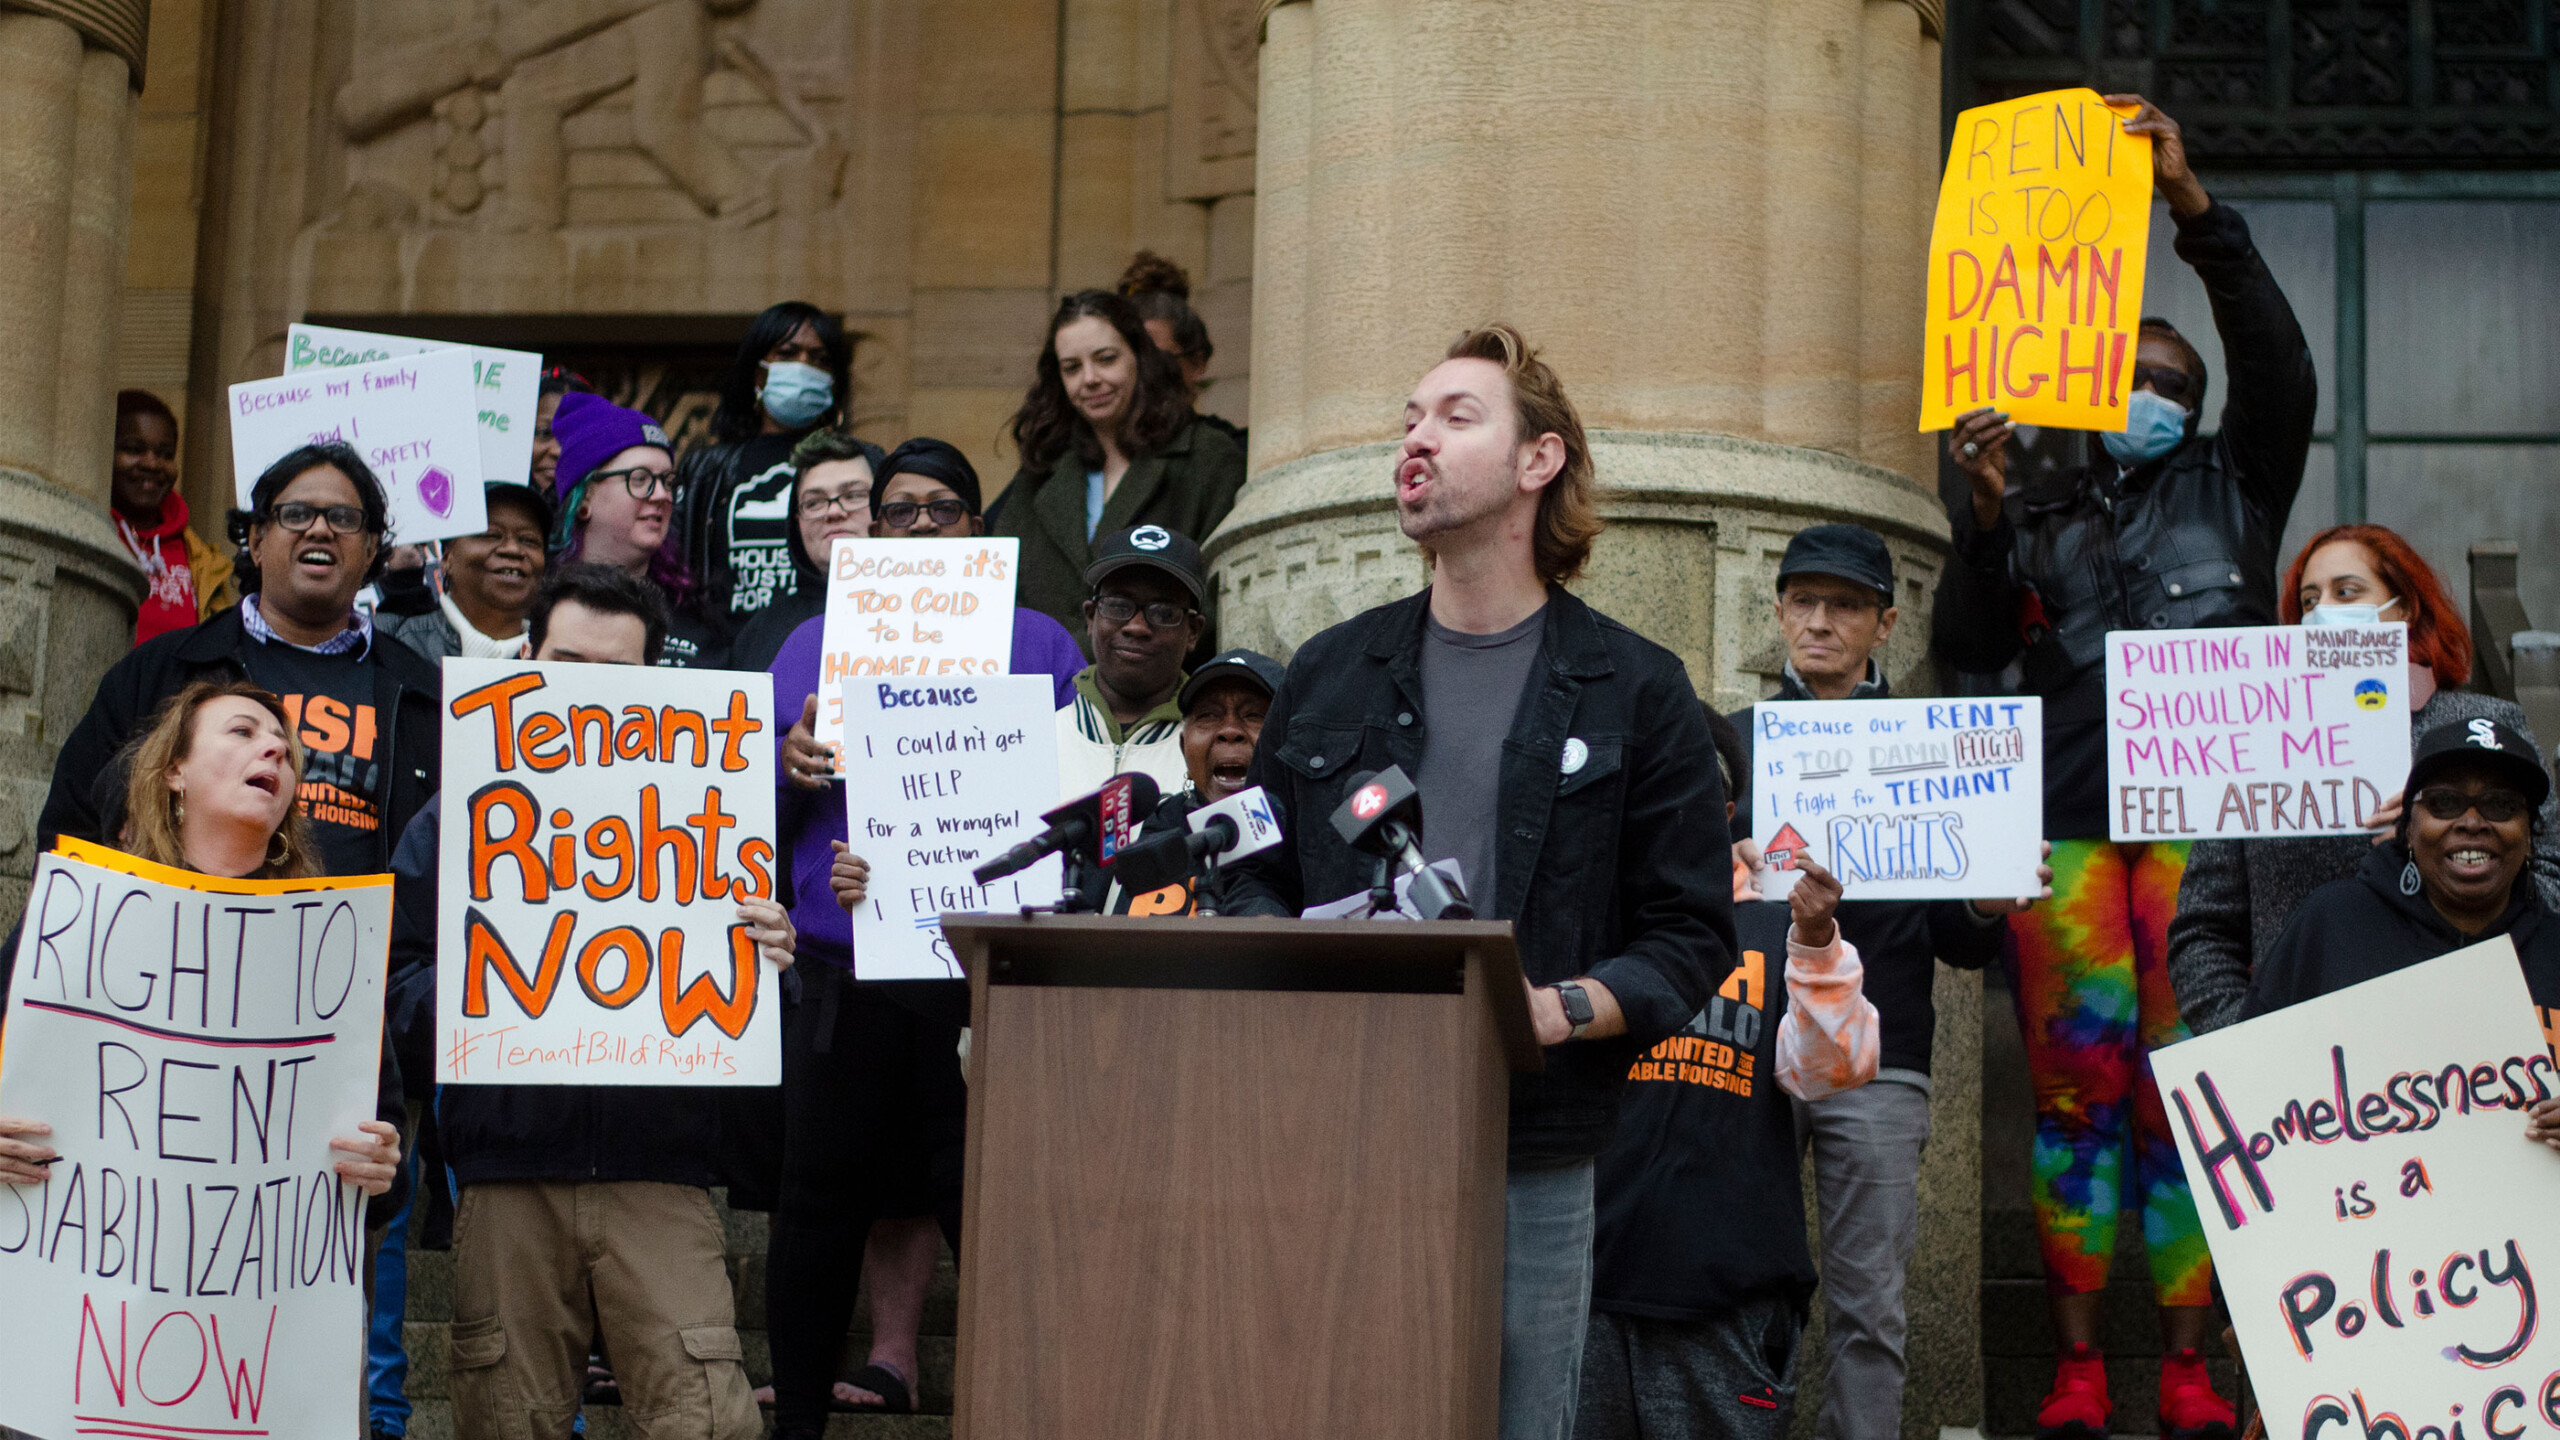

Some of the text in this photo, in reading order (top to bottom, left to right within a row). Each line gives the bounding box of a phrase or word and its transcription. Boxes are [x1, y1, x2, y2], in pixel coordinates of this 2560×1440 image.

[1967, 101, 2116, 180] RENT
[1970, 186, 2112, 246] IS TOO
[1948, 243, 2122, 328] DAMN
[1944, 325, 2127, 407] HIGH!
[238, 367, 418, 416] Because my family
[307, 416, 359, 446] and I
[370, 438, 431, 469] SAFETY
[836, 547, 1007, 580] Because it's
[730, 588, 772, 612] FOR
[847, 587, 979, 616] TOO COLD
[868, 618, 944, 643] to be
[2305, 629, 2402, 648] MAINTENANCE
[825, 652, 999, 684] HOMELESS
[2120, 633, 2290, 677] PUTTING IN
[2306, 650, 2398, 669] REQUESTS
[878, 683, 978, 710] Because
[2116, 673, 2325, 730] SHOULDN'T
[450, 671, 763, 773] Tenant
[865, 734, 873, 758] I
[996, 728, 1026, 752] get
[1762, 704, 2023, 740] Because our RENT
[1768, 731, 2021, 776] is TOO DAMN HIGH
[2126, 723, 2354, 777] MAKE ME
[902, 769, 962, 801] HELP
[1358, 787, 1383, 815] 4
[1772, 767, 2013, 817] I fight for TENANT
[2119, 776, 2382, 833] FEEL AFRAID
[313, 802, 379, 830] HOUSIN
[866, 810, 1019, 839] for a wrongful
[1115, 784, 1130, 850] WBFO
[1239, 800, 1261, 841] WKBW
[1251, 797, 1273, 826] 7
[467, 779, 774, 906] Rights
[907, 846, 979, 867] eviction
[1830, 813, 1967, 882] RIGHTS
[874, 898, 883, 921] I
[910, 883, 995, 913] FIGHT
[33, 867, 275, 1029] RIGHT
[462, 905, 760, 1040] NOW
[1651, 1036, 1734, 1069] UNITED
[1628, 1062, 1752, 1098] ABLE HOUSING
[98, 1041, 316, 1164] RENT
[2170, 1044, 2554, 1231] Homelessness
[2335, 1156, 2433, 1221] is a
[2279, 1238, 2538, 1370] Policy
[75, 1293, 277, 1424] NOW
